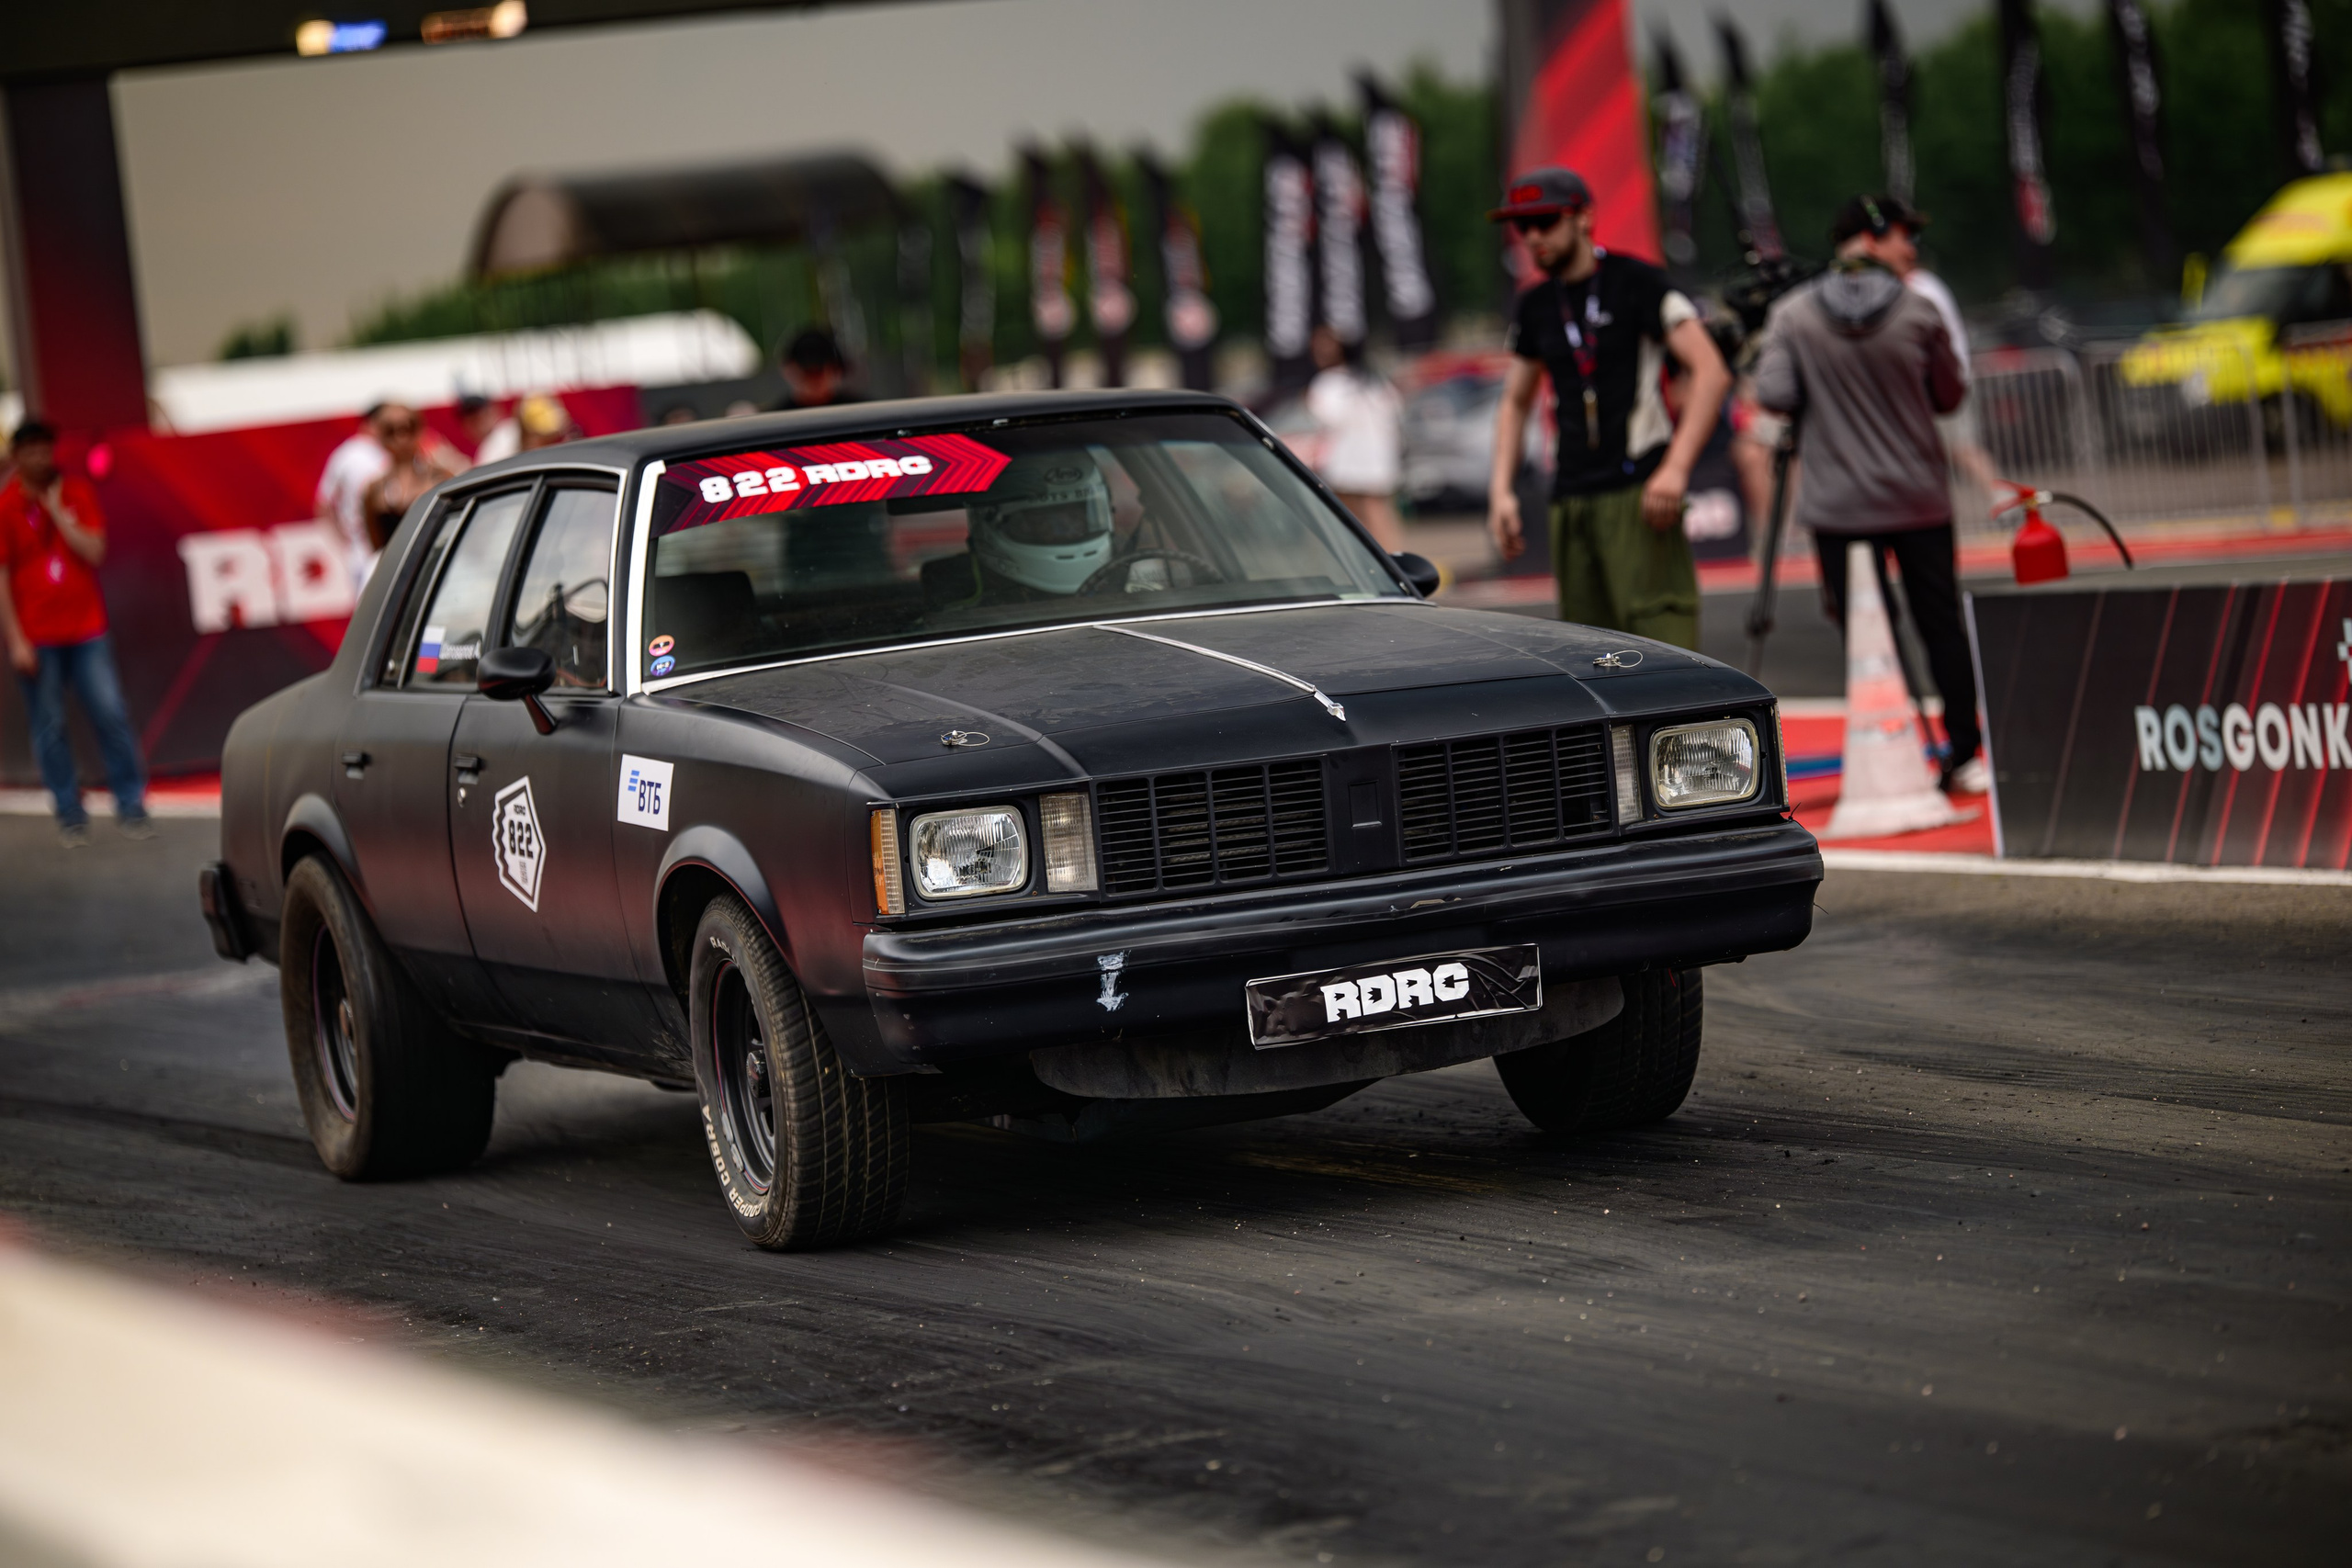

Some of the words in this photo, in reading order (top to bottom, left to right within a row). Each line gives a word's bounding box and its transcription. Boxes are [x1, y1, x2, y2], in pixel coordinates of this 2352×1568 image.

[699, 467, 801, 503] 822
[802, 456, 933, 485] RDRC
[638, 779, 662, 816] ВТБ
[508, 819, 534, 860] 822
[1319, 962, 1470, 1022] RDRC
[702, 1104, 730, 1187] COBRA
[729, 1187, 763, 1218] COOPER
